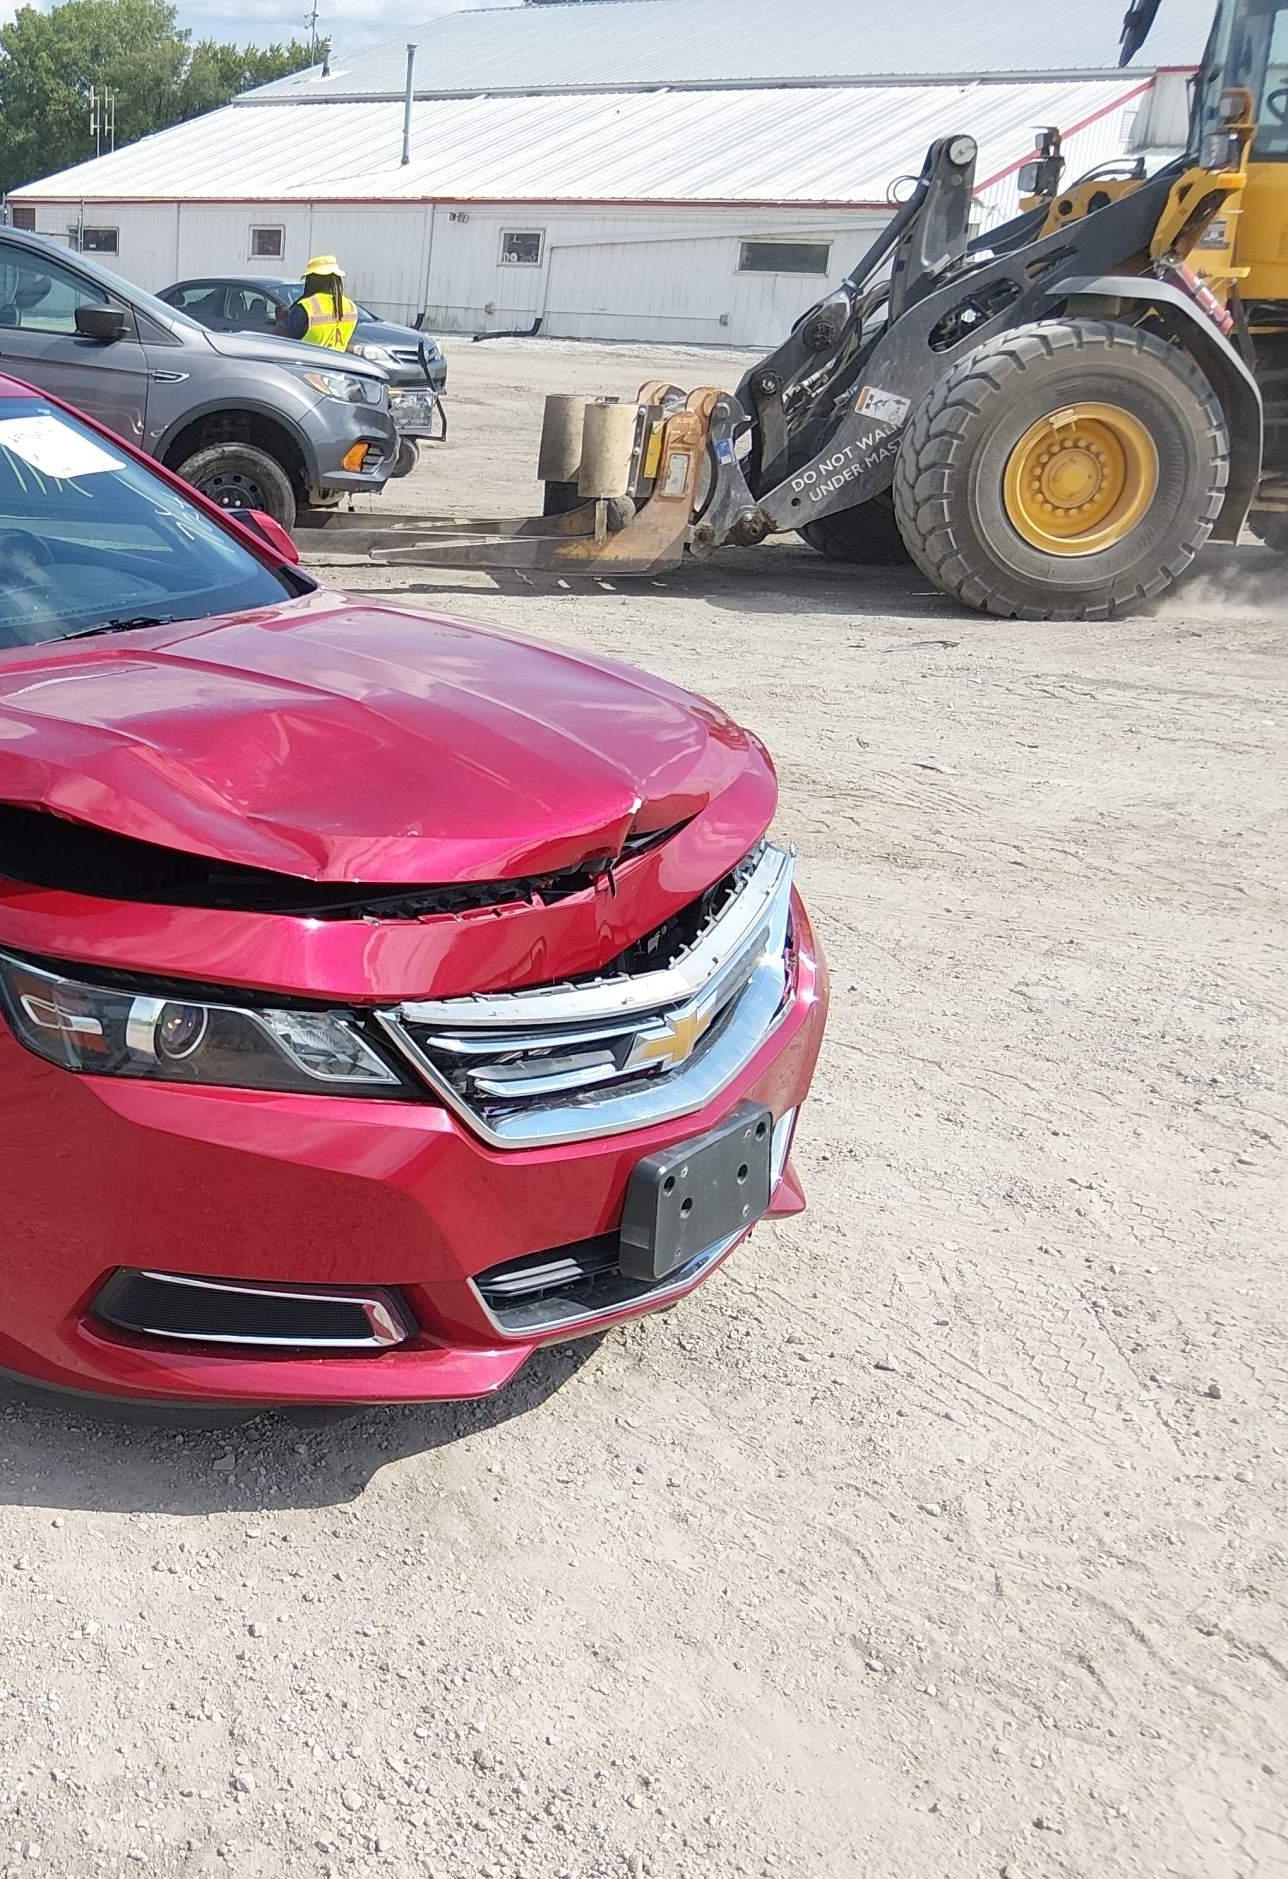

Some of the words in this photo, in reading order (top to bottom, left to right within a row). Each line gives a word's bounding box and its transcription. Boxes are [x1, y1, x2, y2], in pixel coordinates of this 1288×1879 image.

[791, 470, 817, 492] DO
[818, 446, 854, 475] NOT
[808, 463, 864, 502] UNDER
